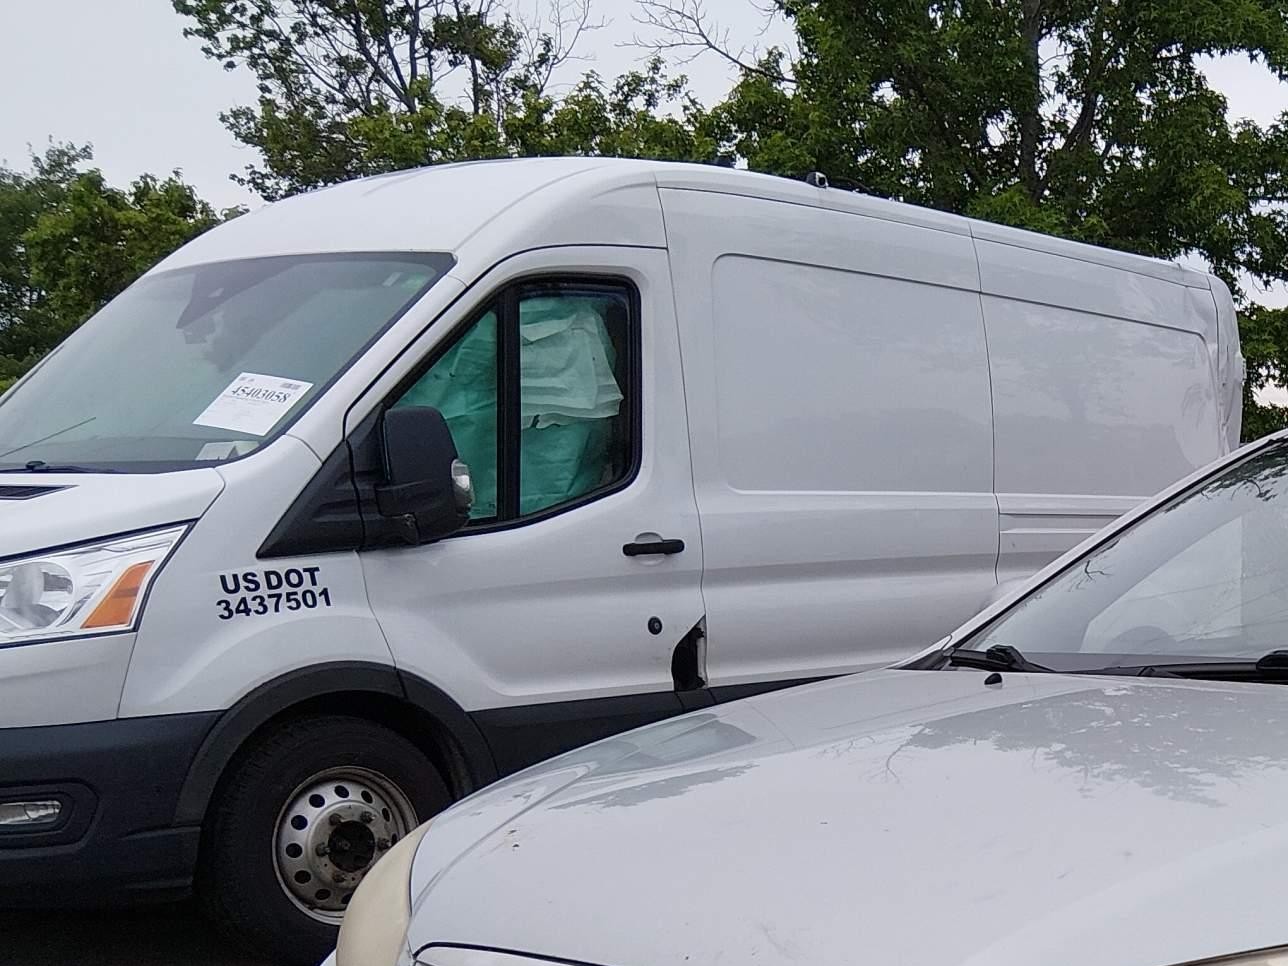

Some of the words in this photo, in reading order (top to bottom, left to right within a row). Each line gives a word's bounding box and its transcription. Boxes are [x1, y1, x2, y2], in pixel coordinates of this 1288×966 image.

[231, 385, 291, 403] 45403058
[219, 573, 261, 594] US
[263, 567, 320, 590] DOT
[216, 587, 332, 620] 3437501
